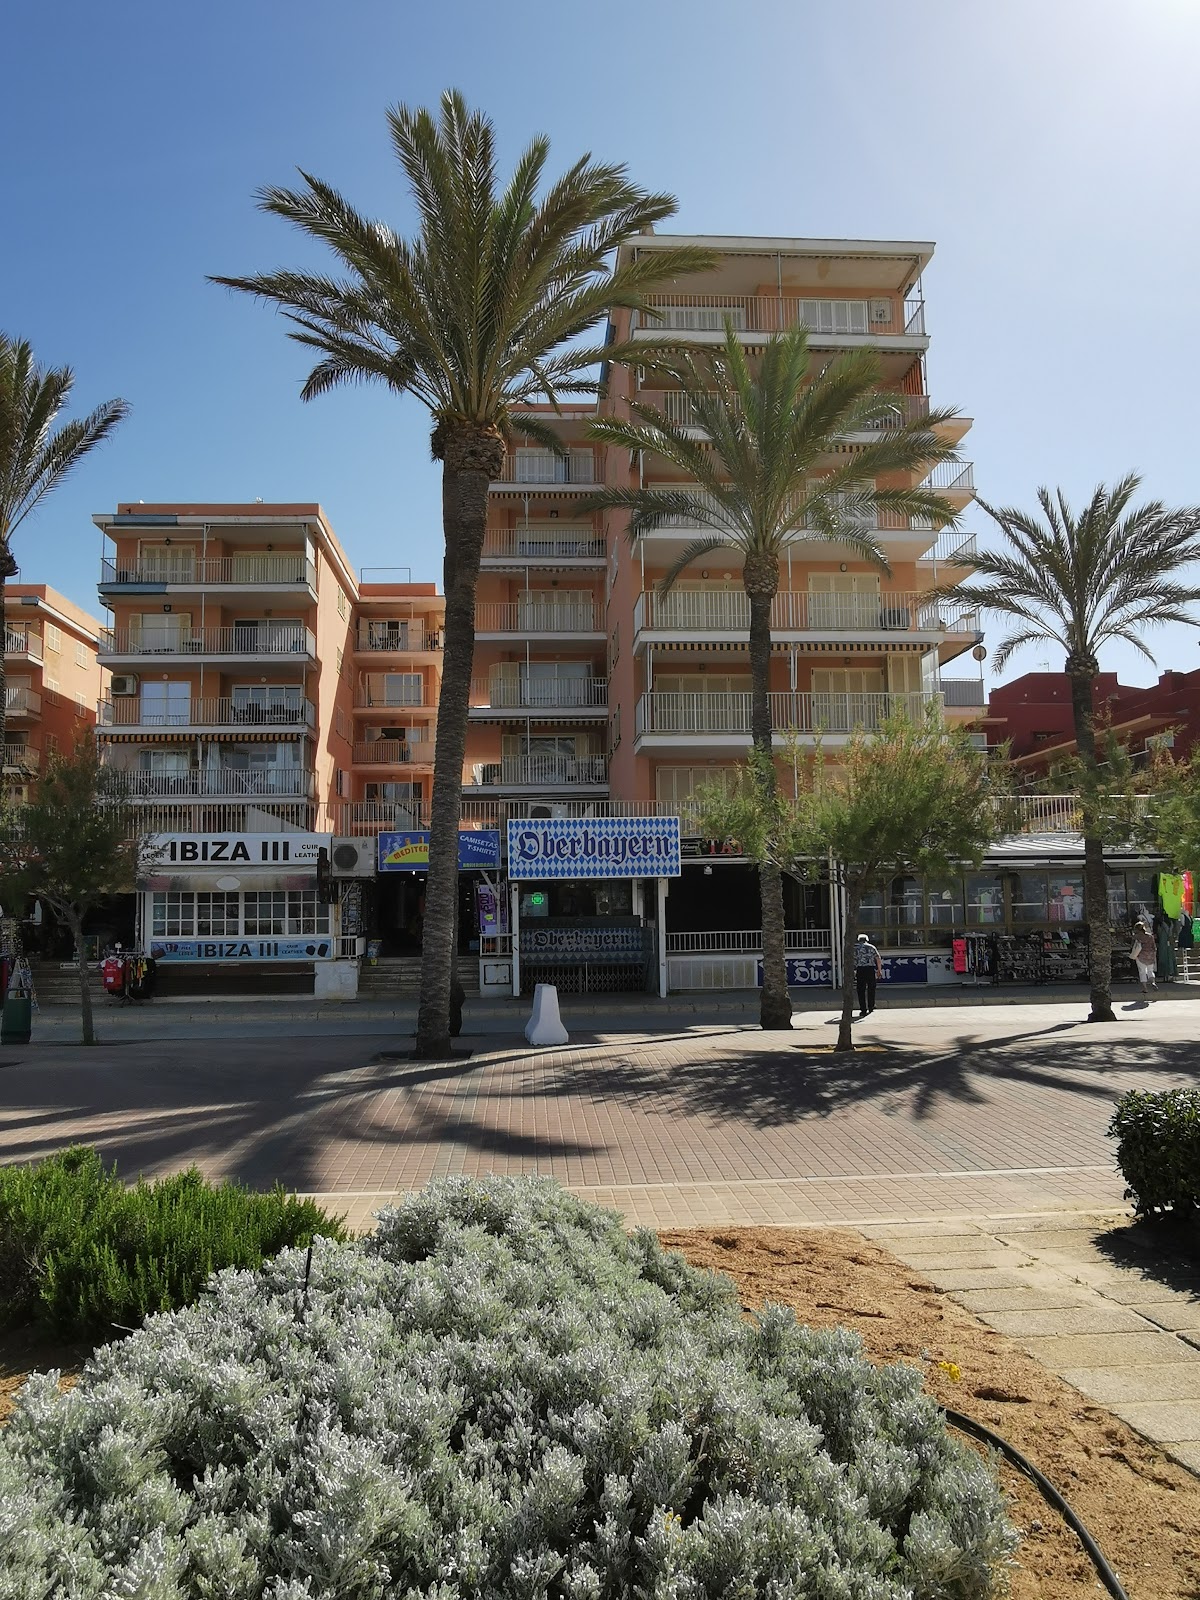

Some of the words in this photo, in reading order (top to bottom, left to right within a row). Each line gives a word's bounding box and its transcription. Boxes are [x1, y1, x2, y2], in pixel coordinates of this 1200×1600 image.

[459, 834, 498, 849] CAMISETAS
[517, 830, 671, 865] Oberbayern
[170, 841, 250, 861] IBIZA
[261, 841, 290, 861] III
[393, 846, 429, 860] MEDITER
[467, 844, 496, 857] T-SHIRTS
[533, 930, 632, 950] Oberbayern
[197, 943, 253, 958] IBIZA
[259, 942, 279, 956] III
